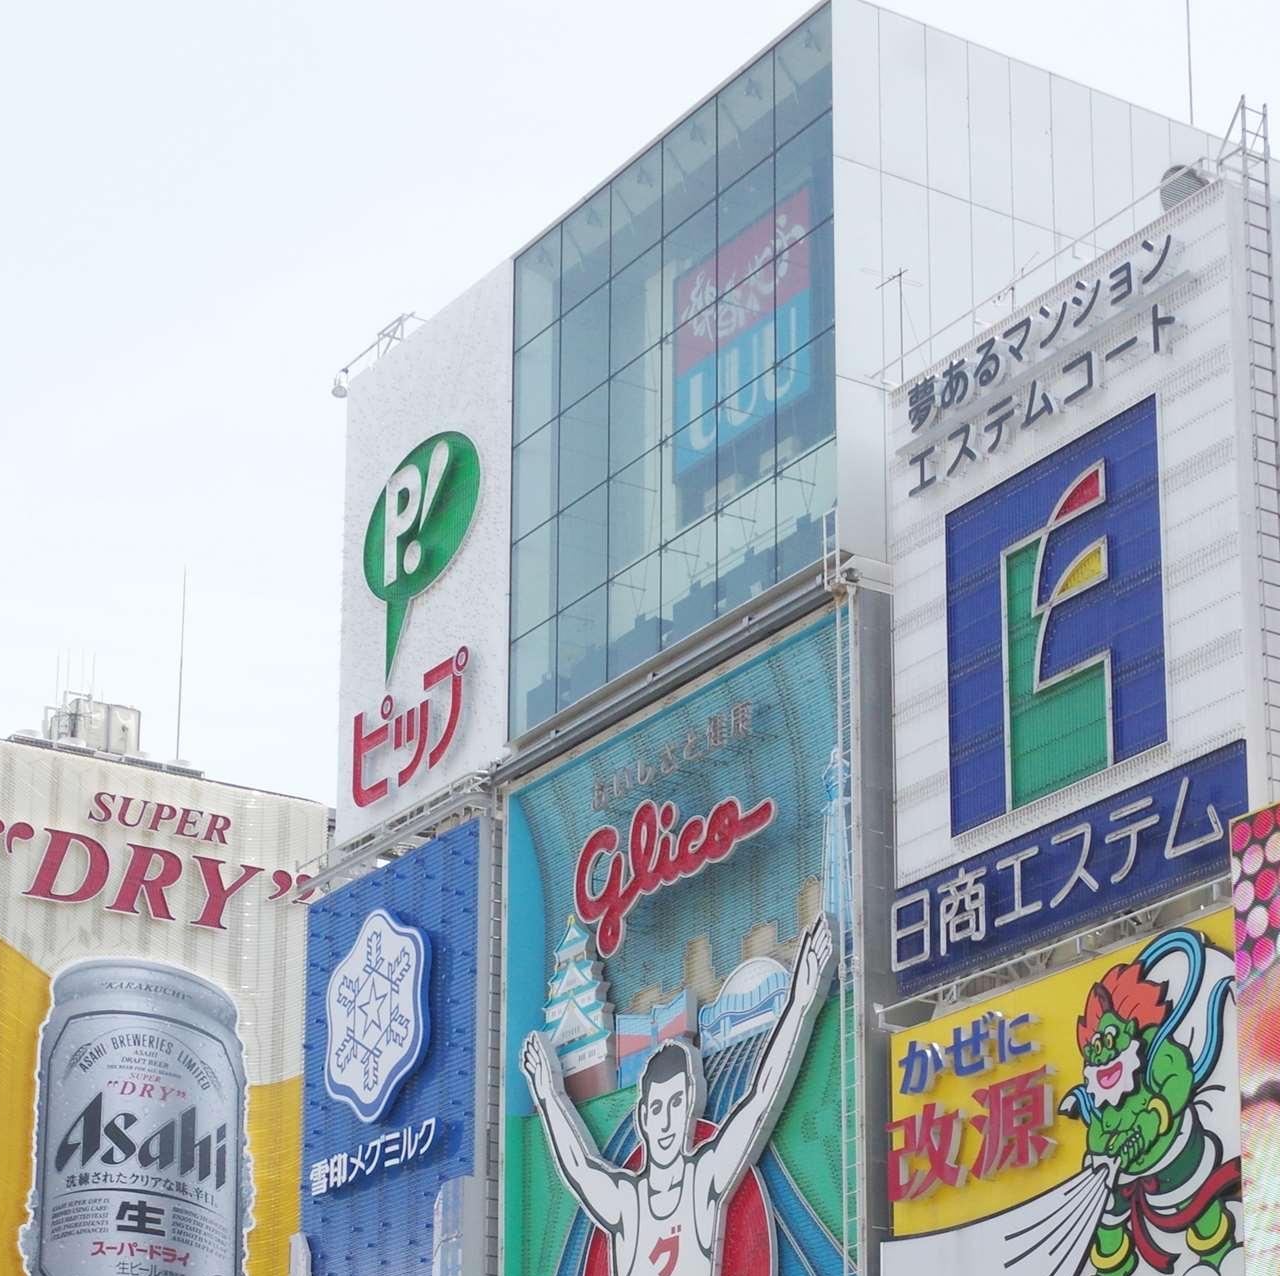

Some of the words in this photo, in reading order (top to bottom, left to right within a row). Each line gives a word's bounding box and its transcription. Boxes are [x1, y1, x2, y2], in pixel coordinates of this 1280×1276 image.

[907, 234, 1172, 434] 夢あるマンション
[908, 303, 1177, 499] エステムコート
[352, 644, 469, 808] ピップ
[593, 700, 756, 816] おいしさと健康
[87, 792, 232, 845] SUPER
[574, 797, 777, 959] Glico
[890, 775, 1225, 972] 日商エステム
[79, 1043, 108, 1073] ASAHI
[111, 1033, 174, 1055] BREWERIES
[177, 1051, 213, 1092] LIMITED
[121, 1056, 146, 1067] DRAFT
[128, 1072, 162, 1083] SUPER
[898, 1010, 1038, 1096] かぜに
[54, 1090, 227, 1192] Asahi
[308, 1115, 437, 1197] 雪印メグミルク
[884, 1064, 1058, 1204] 改源
[90, 1240, 190, 1268] スーパードライ
[115, 1199, 167, 1238] 生
